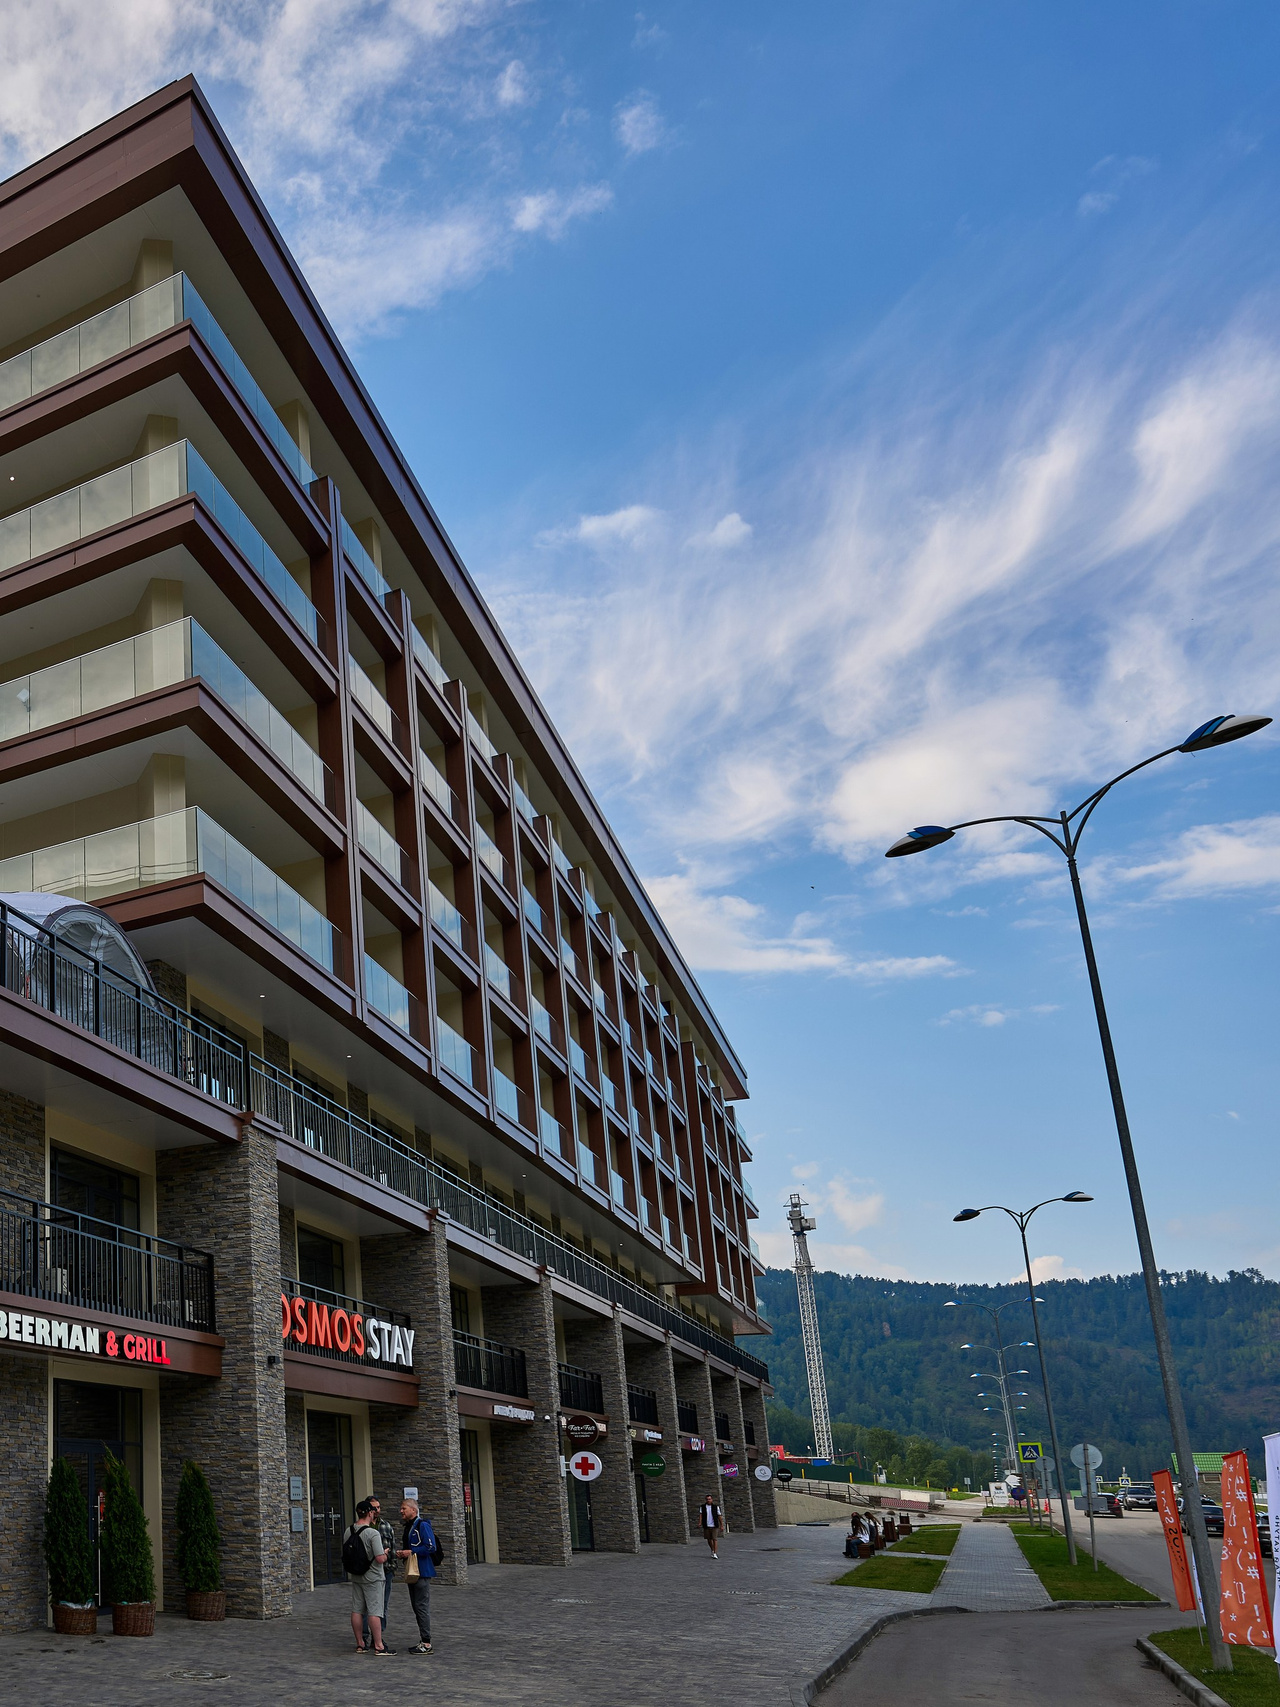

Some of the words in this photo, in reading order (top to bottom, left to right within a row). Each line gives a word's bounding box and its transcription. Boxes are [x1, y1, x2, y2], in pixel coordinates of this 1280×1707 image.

[106, 1330, 119, 1357] &
[123, 1333, 171, 1365] GRILL
[281, 1291, 365, 1356] OSMOS
[366, 1318, 415, 1367] STAY
